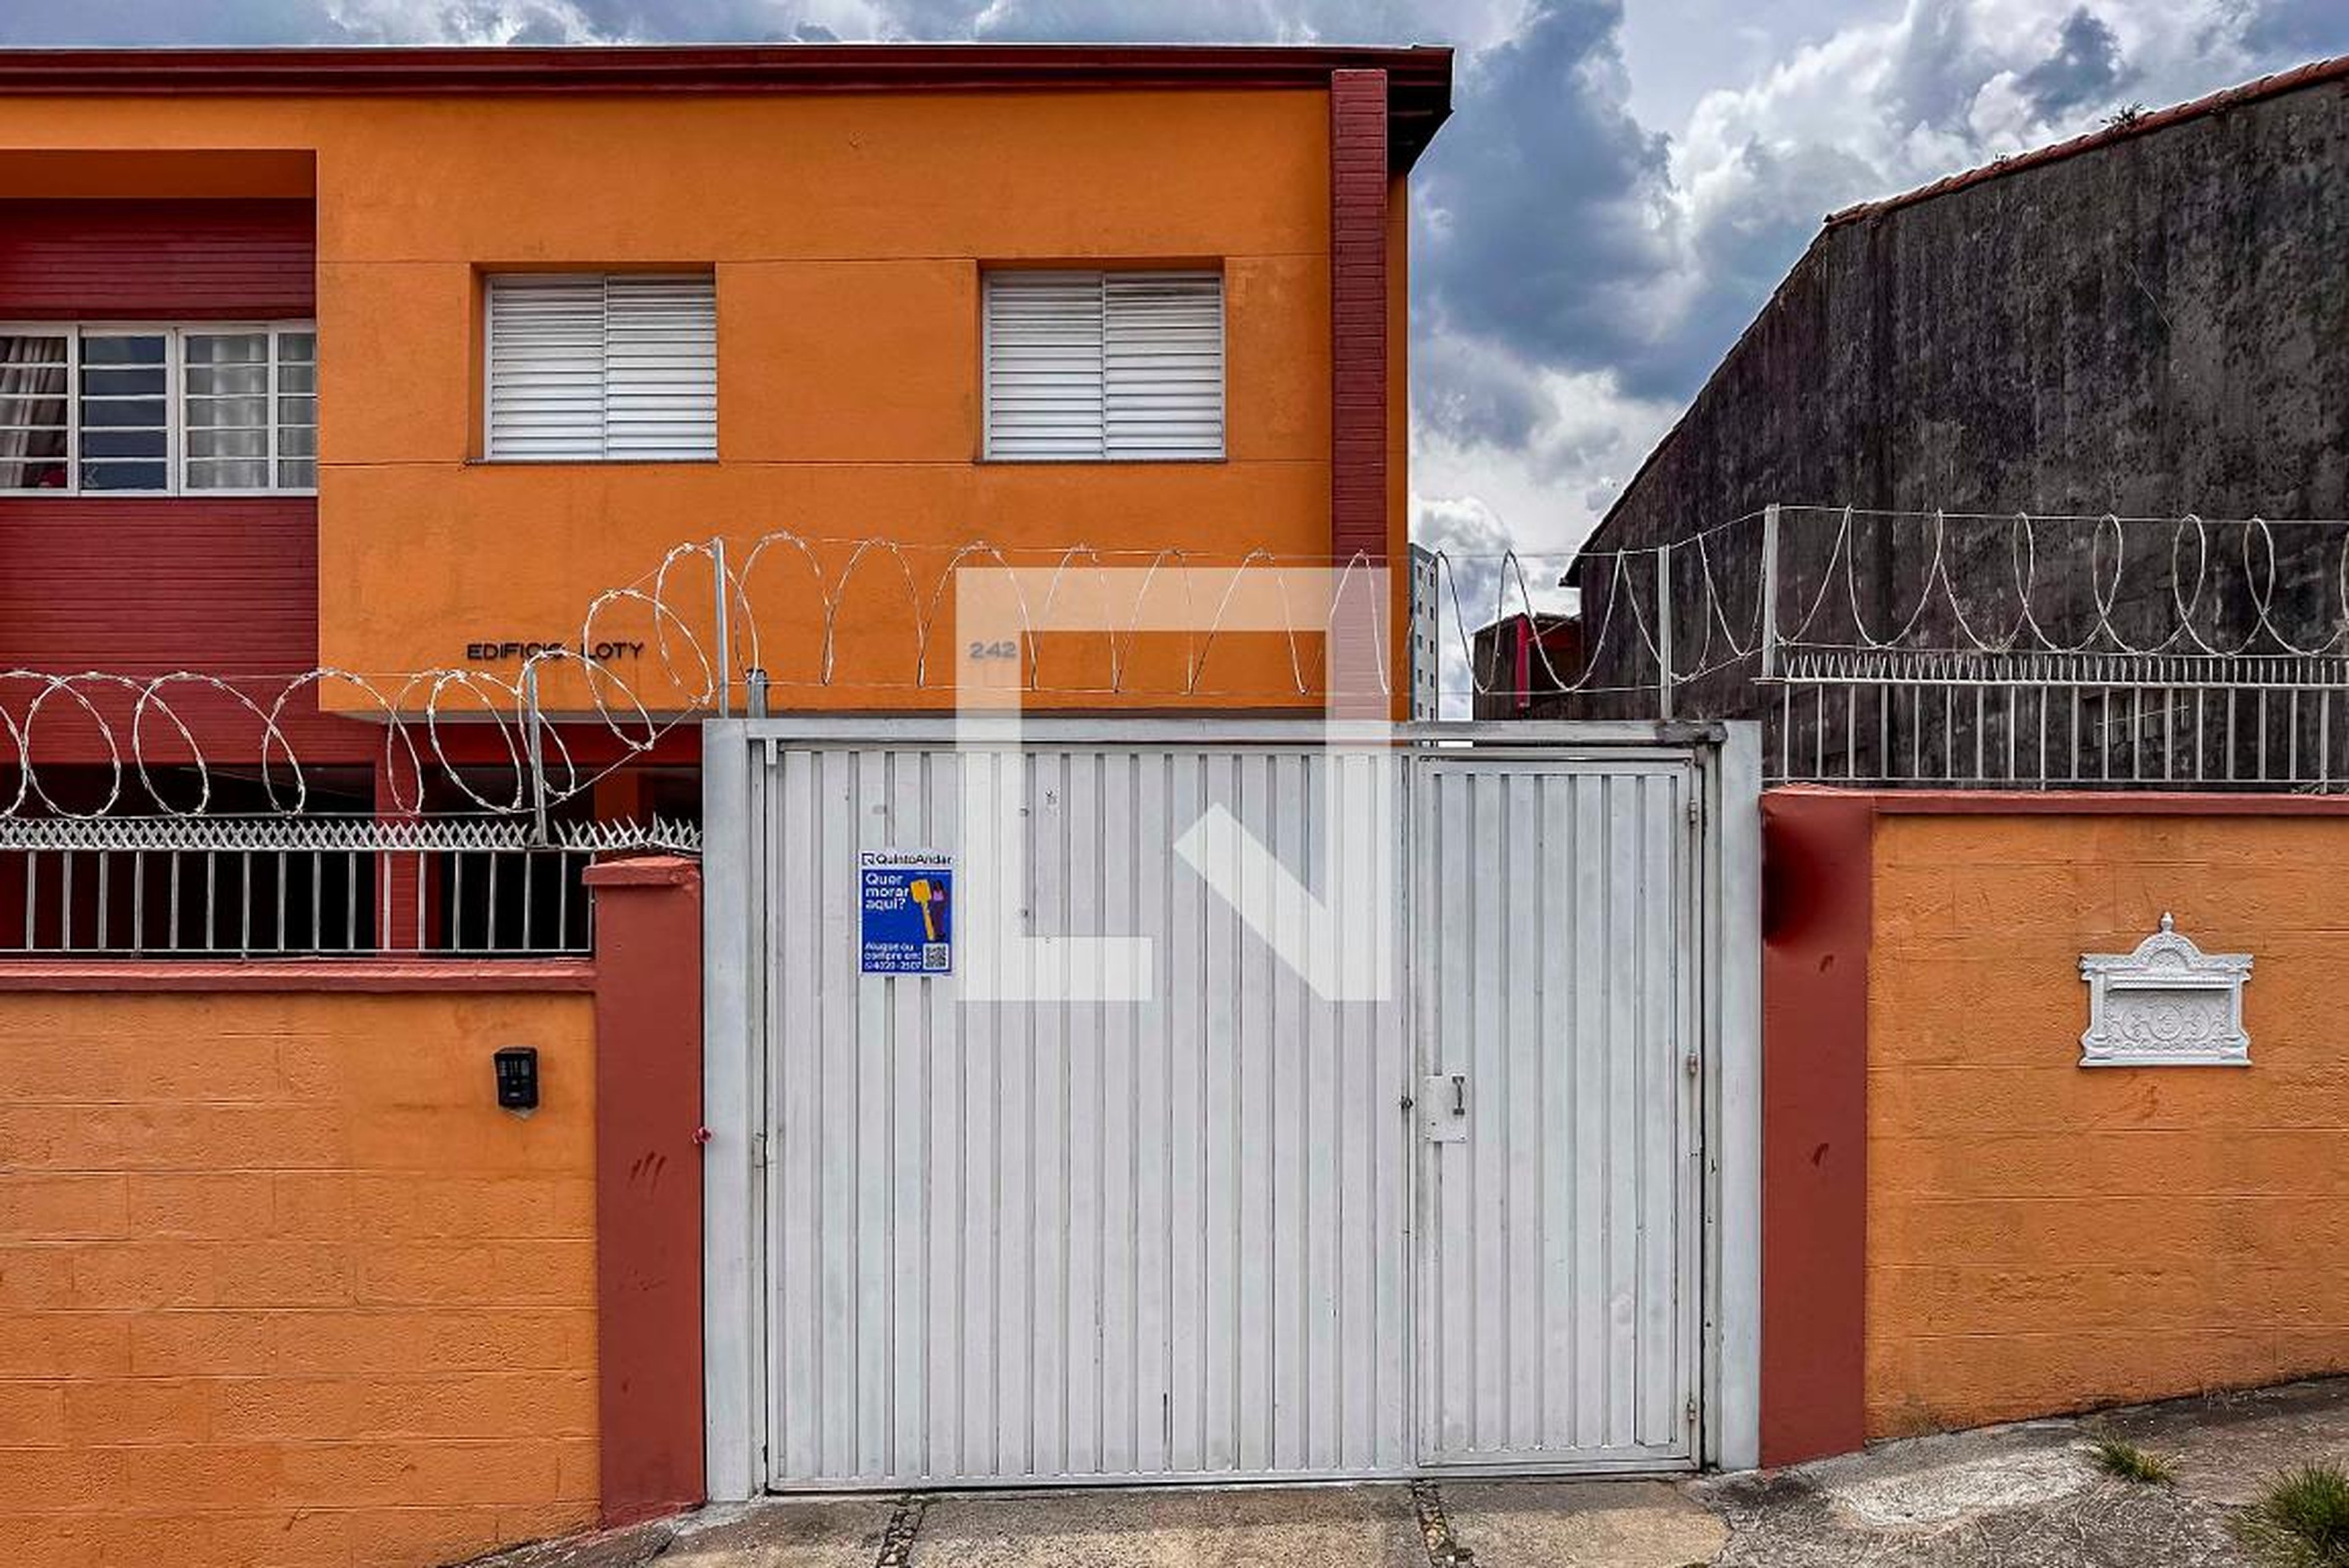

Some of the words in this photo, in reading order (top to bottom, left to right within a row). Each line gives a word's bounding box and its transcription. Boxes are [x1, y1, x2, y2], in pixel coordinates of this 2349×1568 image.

[581, 642, 644, 659] LOTY
[970, 641, 1017, 658] 242
[876, 854, 953, 864] QuintoAndar
[866, 873, 903, 885] Quer
[866, 887, 909, 897] morar
[865, 898, 905, 911] aqui?
